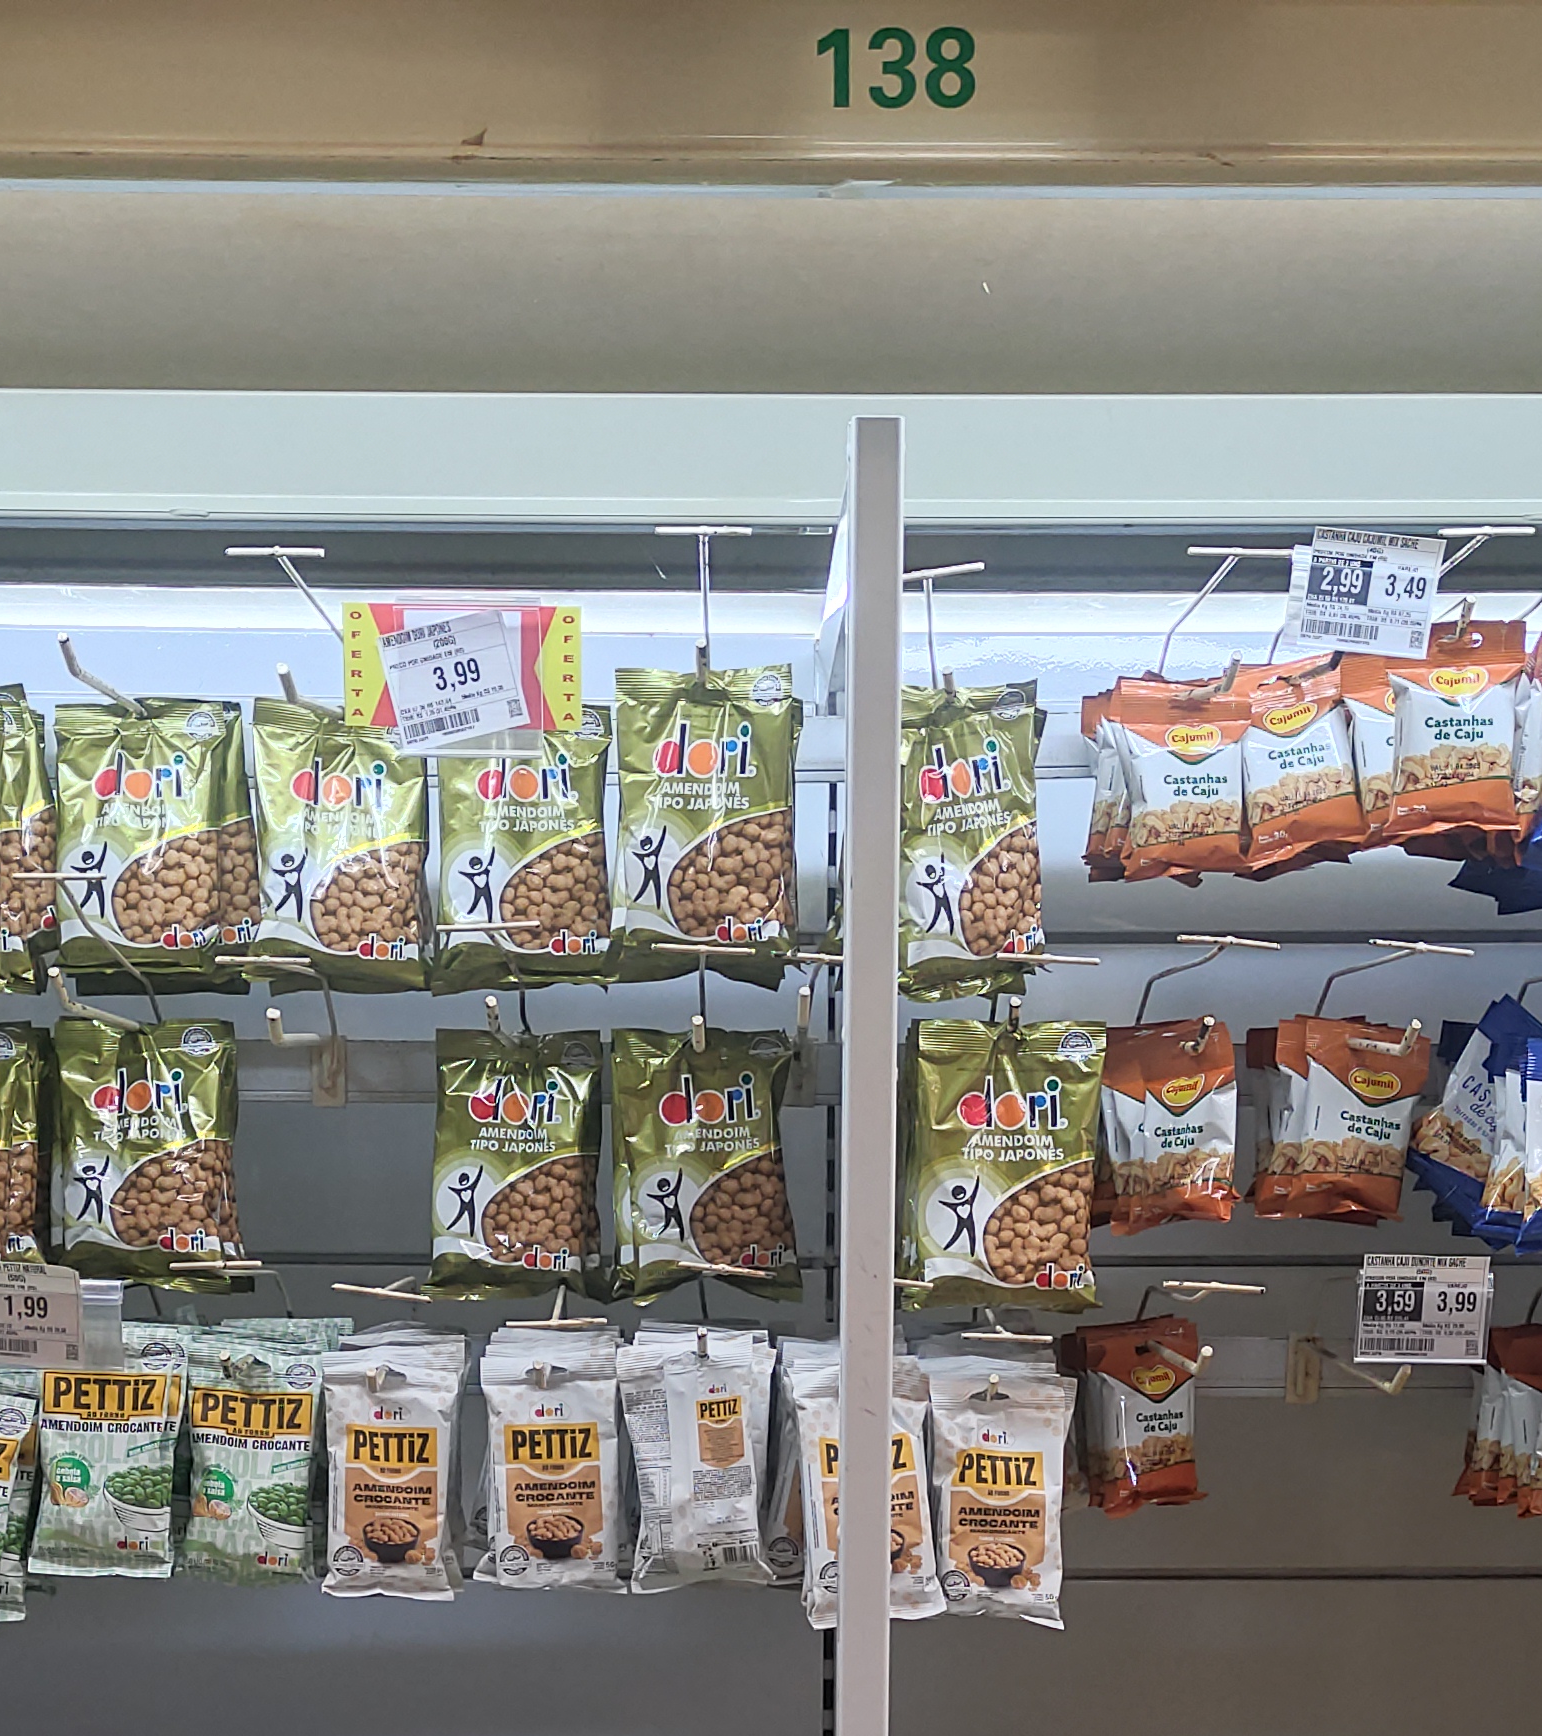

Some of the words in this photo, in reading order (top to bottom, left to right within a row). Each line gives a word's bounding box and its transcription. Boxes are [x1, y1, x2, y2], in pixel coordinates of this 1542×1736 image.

[816, 26, 976, 109] 138
[1321, 566, 1363, 595] 2,99
[1385, 574, 1427, 601] 3,49
[349, 611, 365, 717] OFERTA
[562, 615, 576, 721] OFERTA
[432, 657, 480, 692] 3,99
[1434, 672, 1483, 688] Cajumil
[1268, 704, 1314, 726] Cajumil
[1424, 715, 1494, 728] Castanhas
[1171, 731, 1215, 745] Cajumil
[1433, 728, 1453, 741] de
[1455, 728, 1484, 743] Caju
[653, 721, 751, 779] dori
[1267, 741, 1332, 762] Castanhas
[1279, 756, 1298, 770] de
[1301, 753, 1325, 768] Caju
[1163, 772, 1228, 787] Castanhas
[1172, 785, 1195, 798] de
[1196, 785, 1220, 799] Caju
[1352, 1072, 1396, 1090] Cajumil
[659, 1071, 756, 1125] dori
[957, 1076, 1061, 1131] dori
[1340, 1111, 1401, 1130] Castanhas
[478, 1127, 548, 1140] AMENDOIM
[1153, 1123, 1204, 1139] Castanhas
[1347, 1123, 1363, 1136] de
[1364, 1124, 1392, 1140] Caju
[470, 1139, 499, 1151] TIPO
[961, 1147, 995, 1162] TIPO
[1367, 1256, 1395, 1267] CASTANHA
[3, 1295, 48, 1320] 1,99
[1376, 1290, 1415, 1316] 3,59
[1437, 1291, 1477, 1317] 3,99
[1135, 1410, 1185, 1423] Castanhas
[251, 1438, 311, 1452] CROCANTE
[352, 1482, 433, 1495] AMENDOIM
[513, 1480, 597, 1493] AMENDOIM
[353, 1494, 432, 1506] CROCANTE
[515, 1491, 596, 1502] CROCANTE
[958, 1507, 1041, 1519] AMENDOIM
[958, 1518, 1039, 1529] CROCANTE
